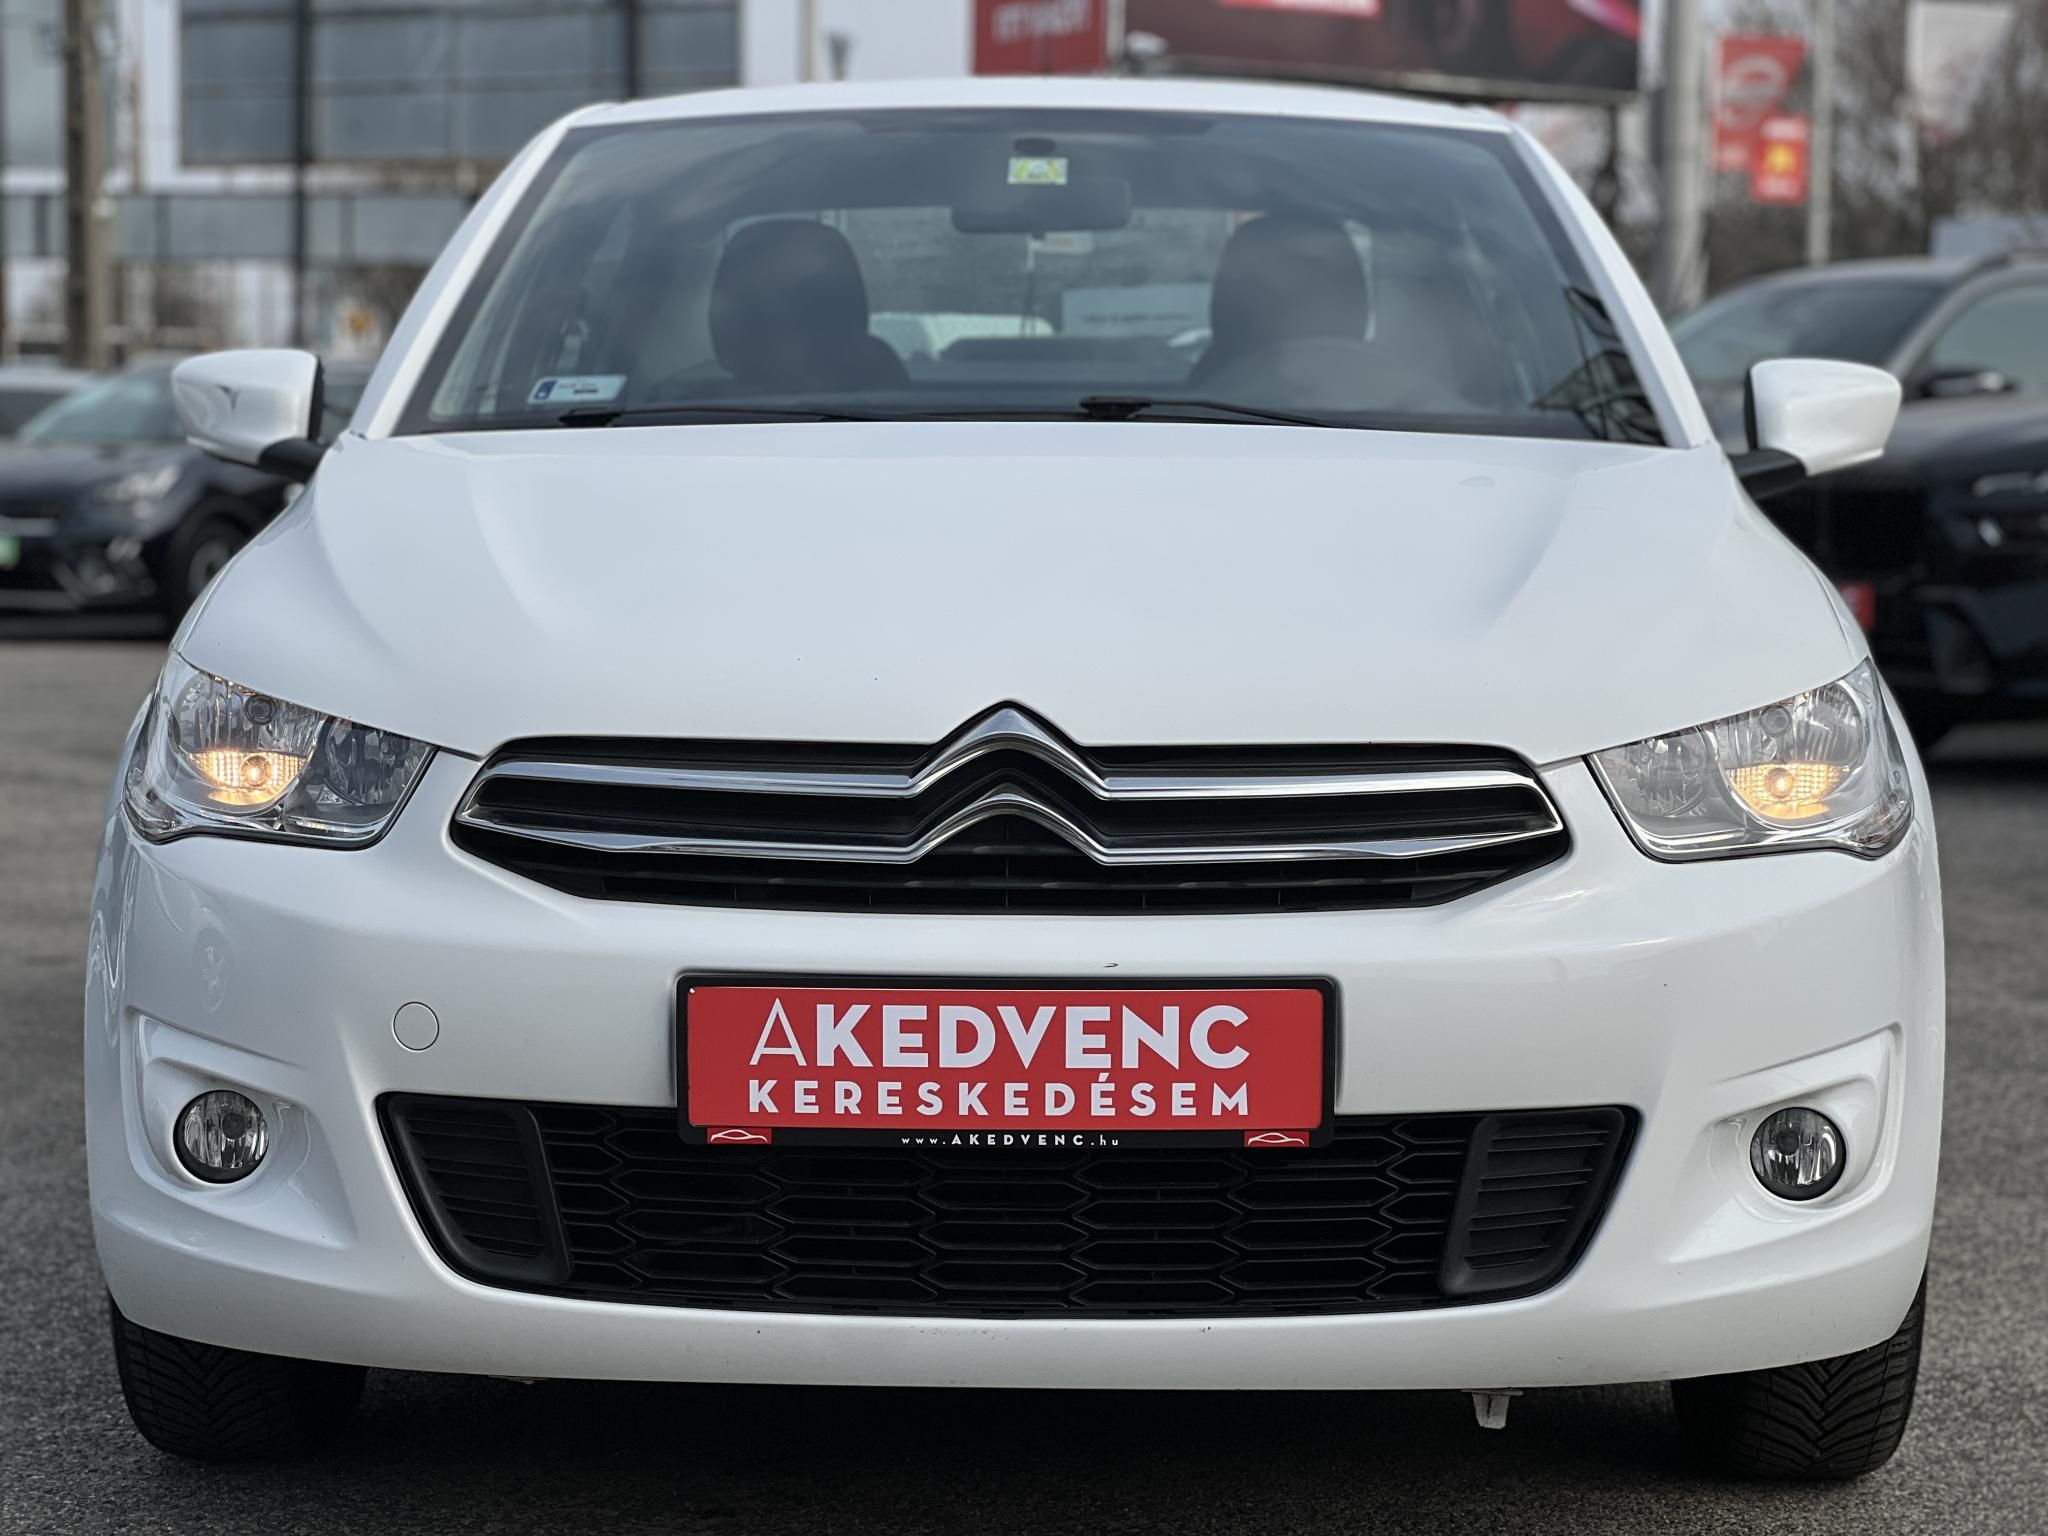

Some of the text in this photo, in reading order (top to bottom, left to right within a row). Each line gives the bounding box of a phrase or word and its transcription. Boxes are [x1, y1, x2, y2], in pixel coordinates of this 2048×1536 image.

[749, 997, 1250, 1070] AKEDVENC
[749, 1072, 1249, 1117] KERESKEDÉSEM
[901, 1133, 1119, 1146] www.AKEDVENC.hu
